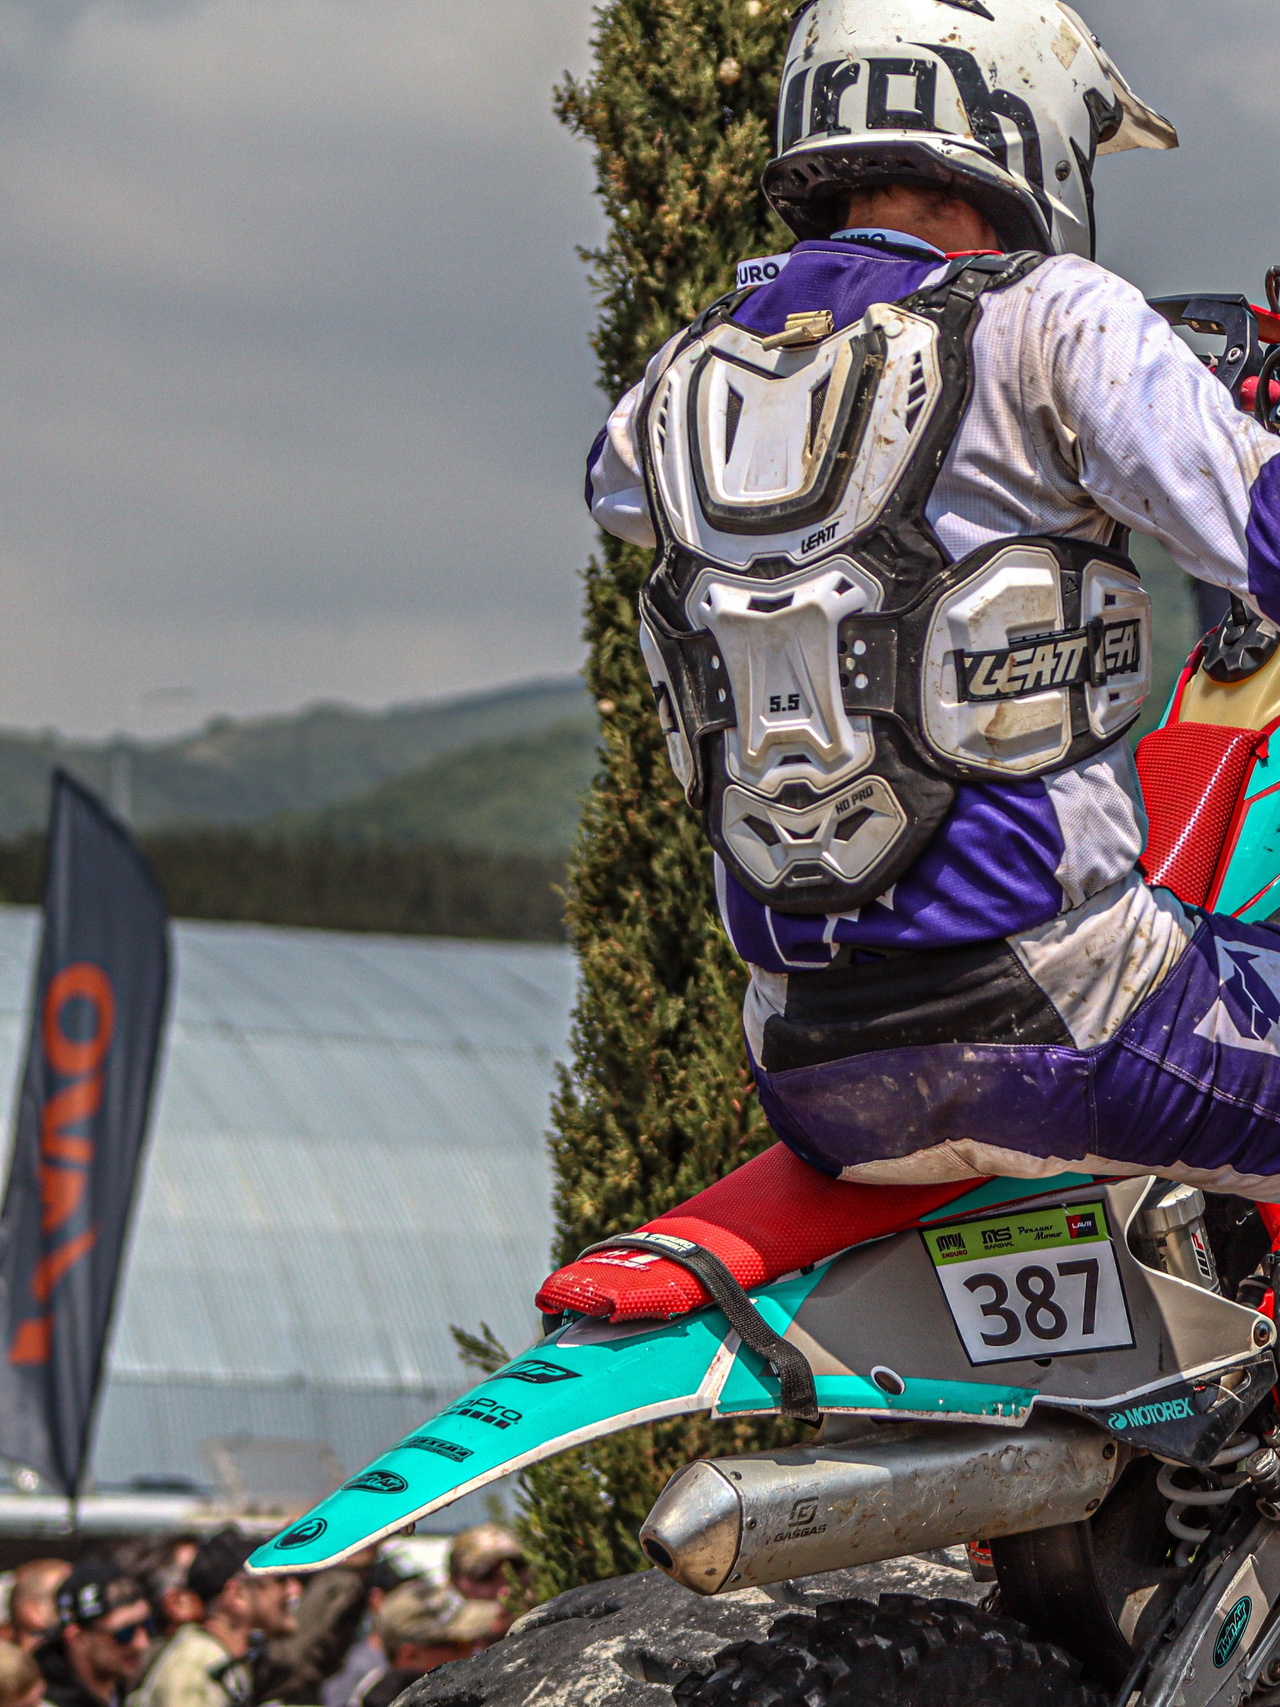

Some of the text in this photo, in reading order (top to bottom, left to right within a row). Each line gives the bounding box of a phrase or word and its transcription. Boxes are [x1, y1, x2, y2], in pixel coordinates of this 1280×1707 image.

[737, 262, 780, 285] URO
[801, 521, 840, 555] LEATT
[969, 638, 1088, 695] LEATT
[769, 694, 800, 713] 5.5
[852, 785, 874, 806] PRO
[1072, 1220, 1092, 1229] LAVR
[942, 1249, 968, 1259] ENDURO
[963, 1258, 1099, 1346] 387
[452, 1398, 523, 1422] oPro
[1125, 1397, 1194, 1427] MOTOREX
[773, 1524, 828, 1542] GASGAS
